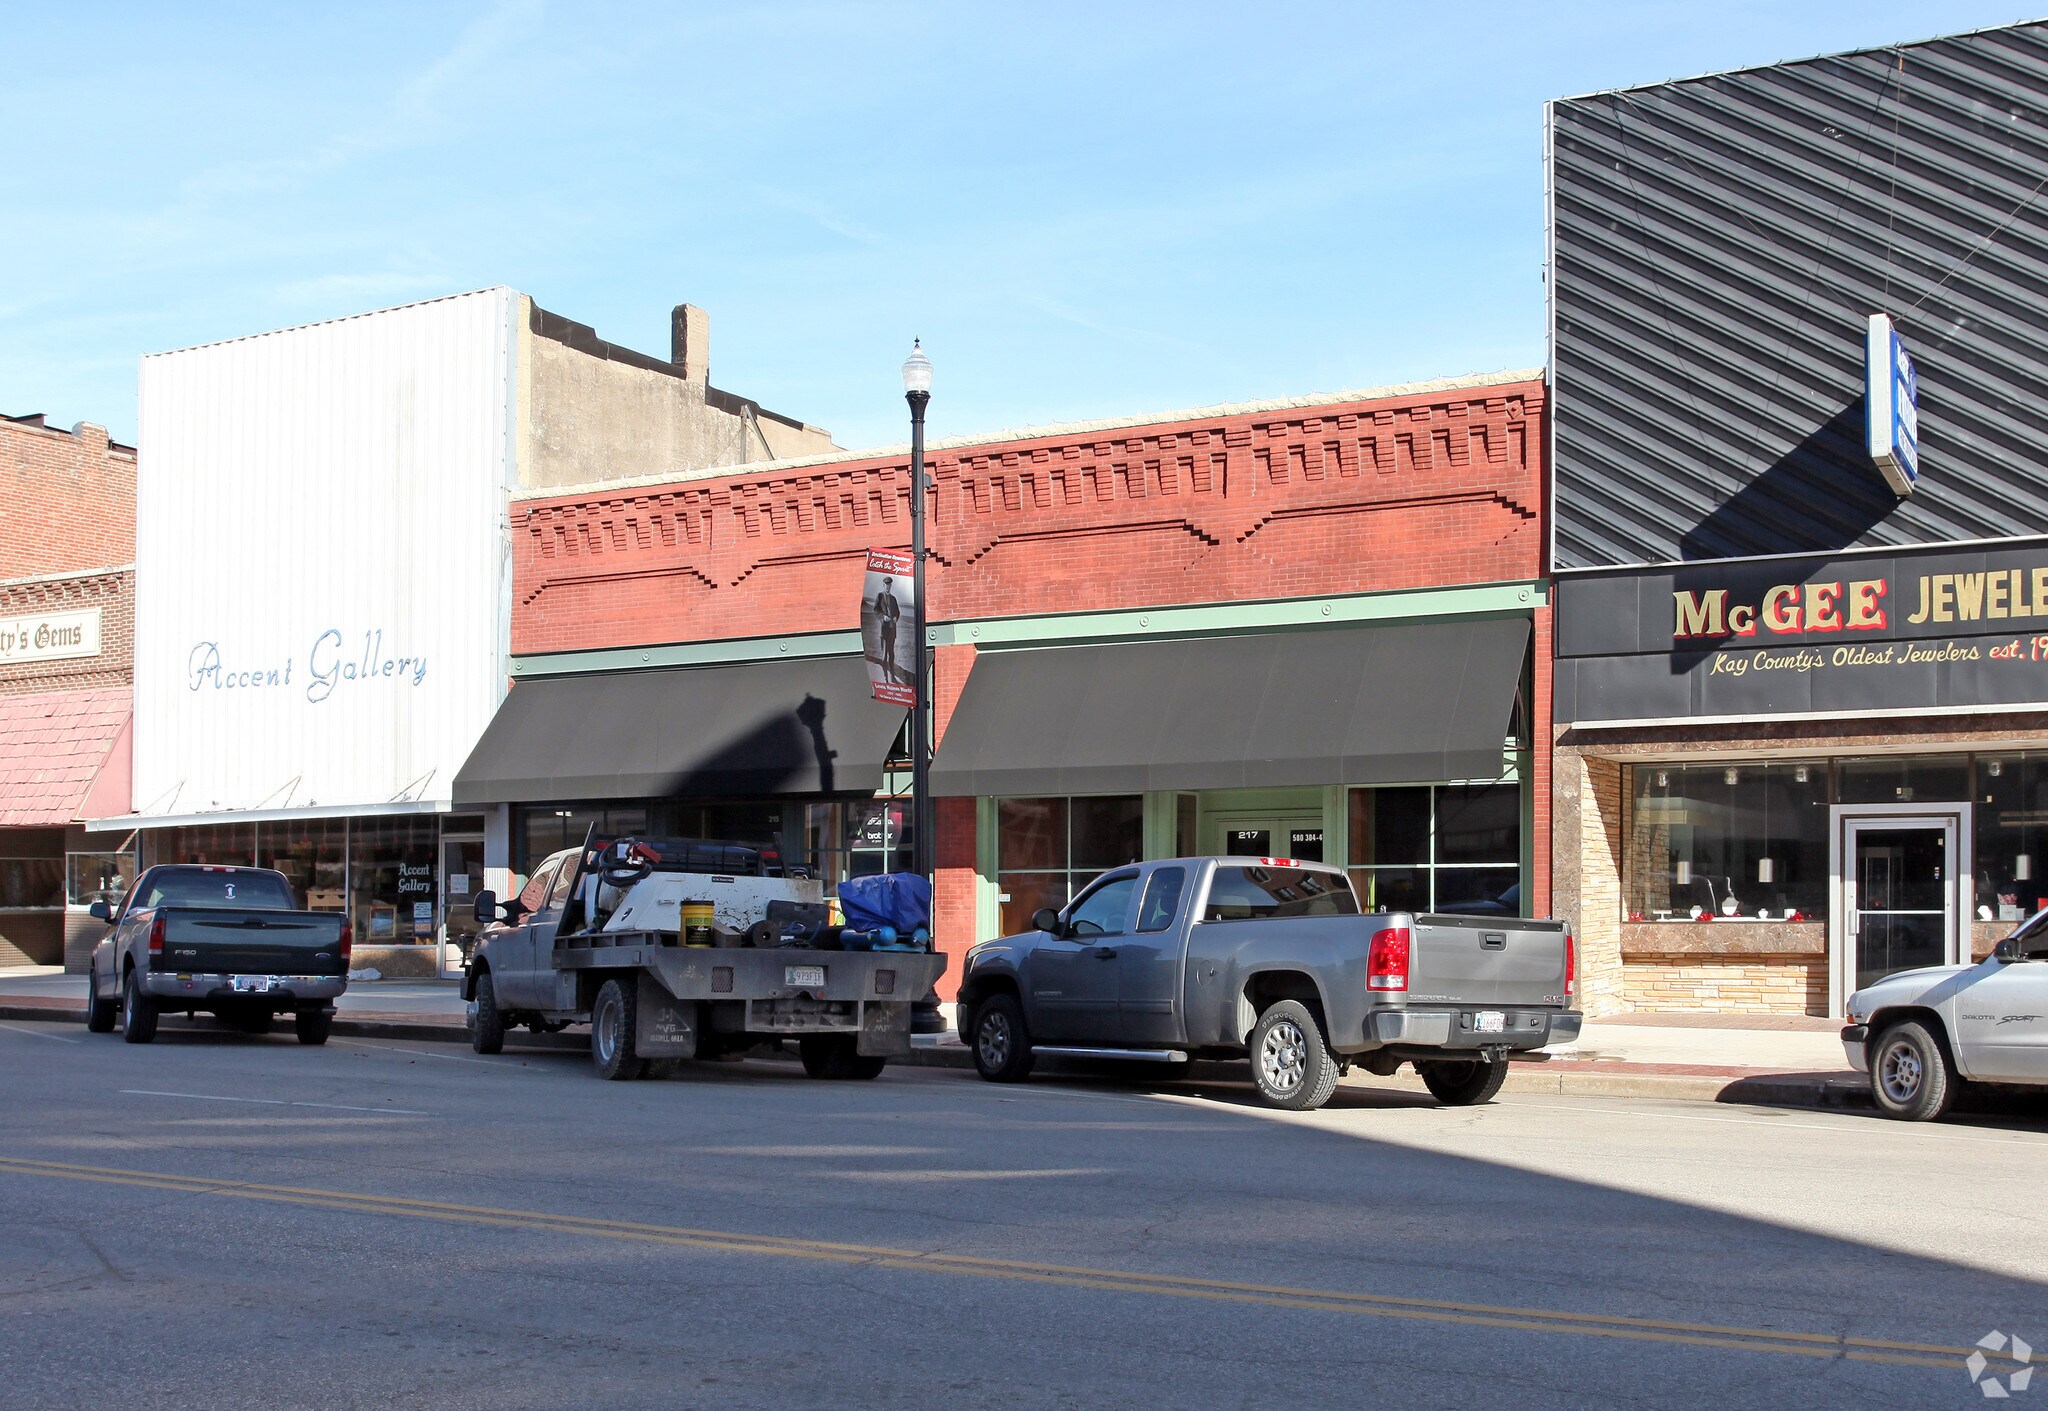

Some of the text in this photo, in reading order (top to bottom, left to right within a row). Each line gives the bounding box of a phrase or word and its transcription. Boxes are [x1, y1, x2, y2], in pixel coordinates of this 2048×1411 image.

[1673, 578, 1887, 639] McGEE
[34, 623, 82, 649] Gems
[189, 628, 427, 703] Accent Gallery
[1710, 652, 1748, 676] Kay
[1753, 649, 1826, 672] County's
[1832, 646, 1894, 667] Oldest
[1897, 642, 1982, 665] Jewelers
[1989, 640, 2027, 661] est.
[867, 832, 893, 840] brotr
[1238, 831, 1258, 839] 217
[1292, 833, 1304, 842] 580
[398, 862, 429, 876] Accent
[397, 878, 431, 894] Gallery
